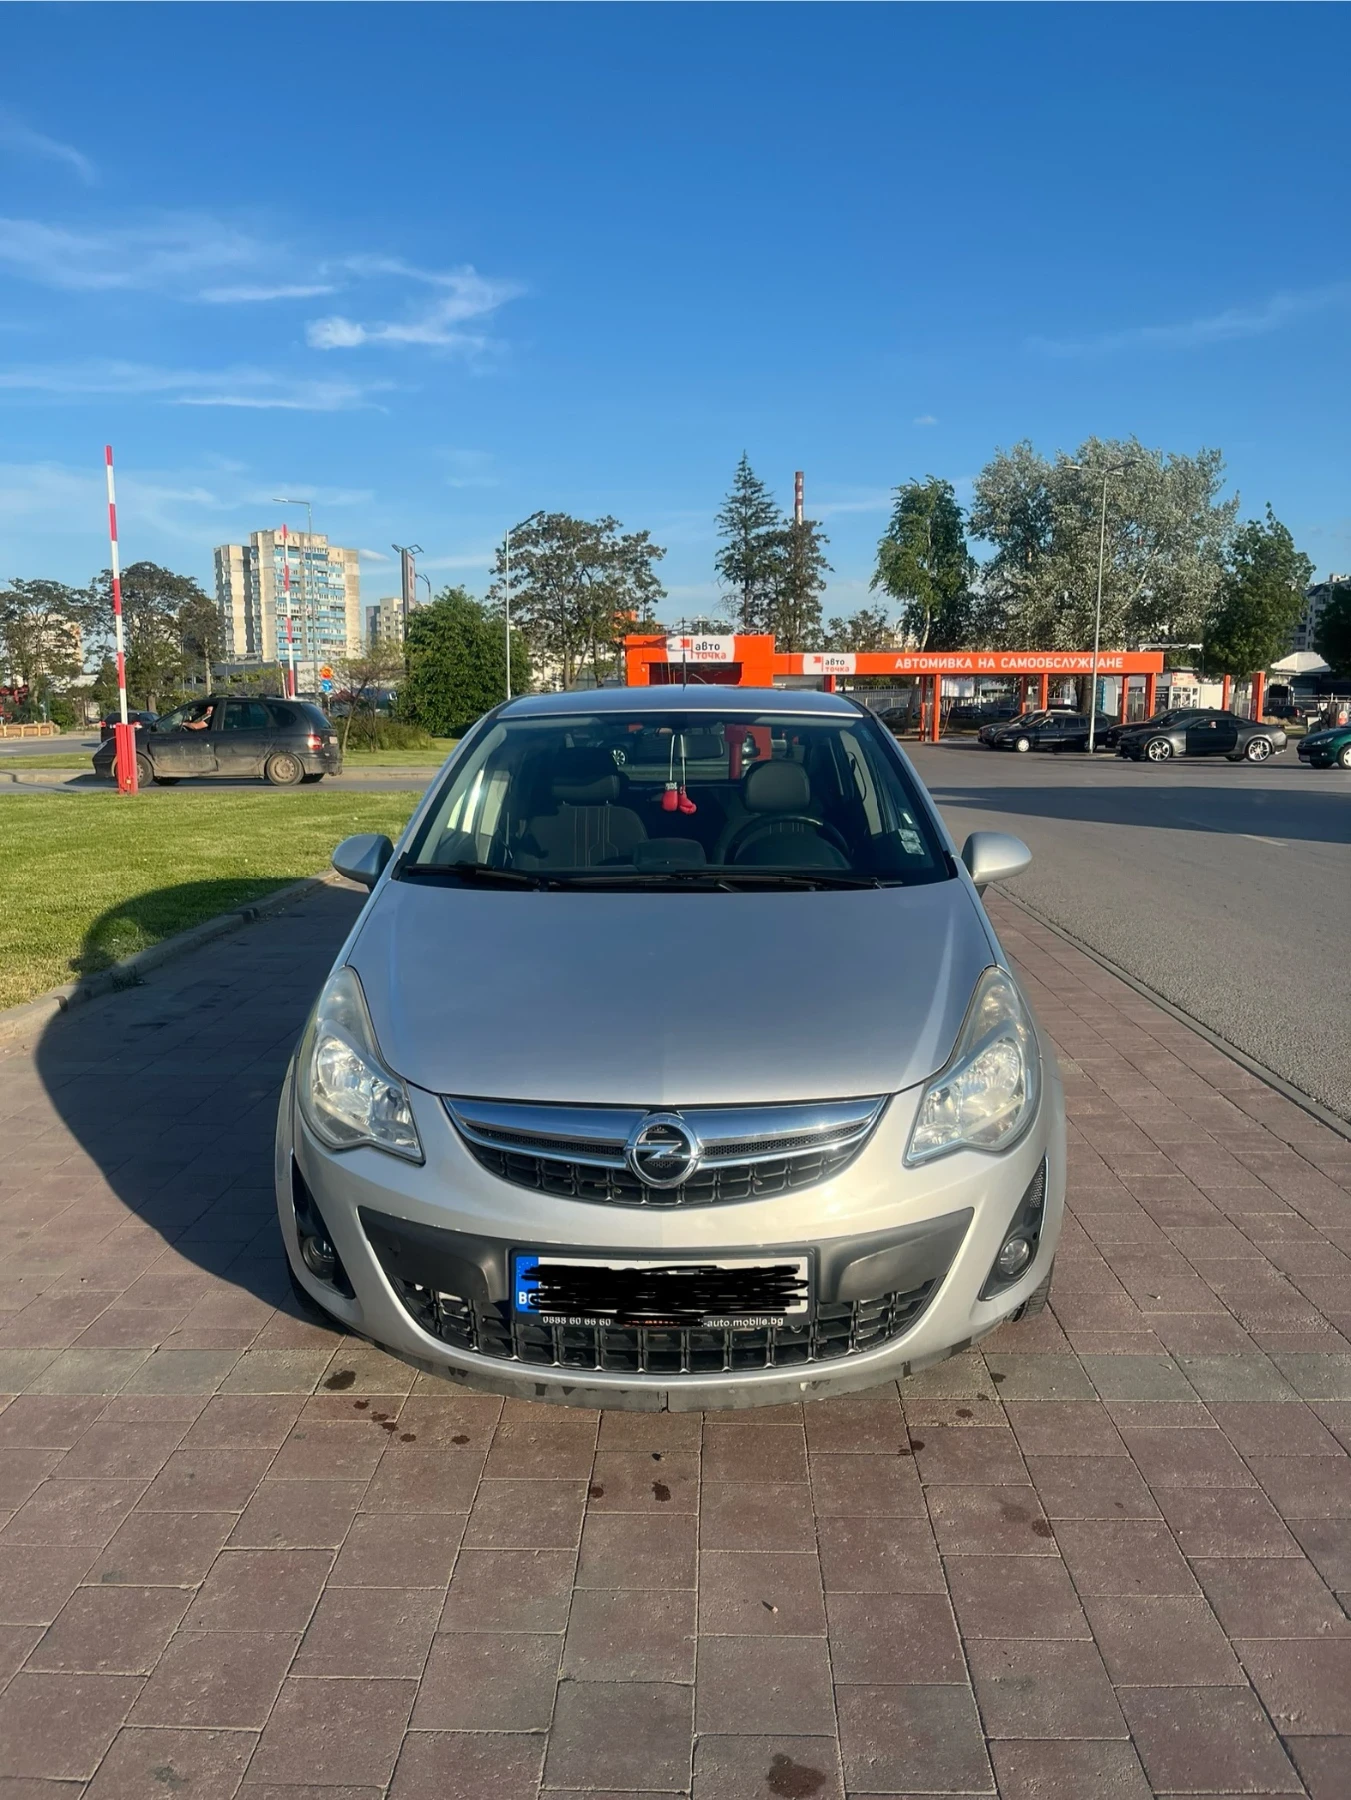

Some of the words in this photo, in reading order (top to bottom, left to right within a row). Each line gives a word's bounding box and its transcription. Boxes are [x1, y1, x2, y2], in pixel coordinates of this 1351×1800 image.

[695, 642, 720, 651] авто
[696, 652, 727, 660] точка
[825, 658, 845, 666] авто
[895, 658, 973, 669] АВТОМИВКА
[978, 658, 996, 669] НА
